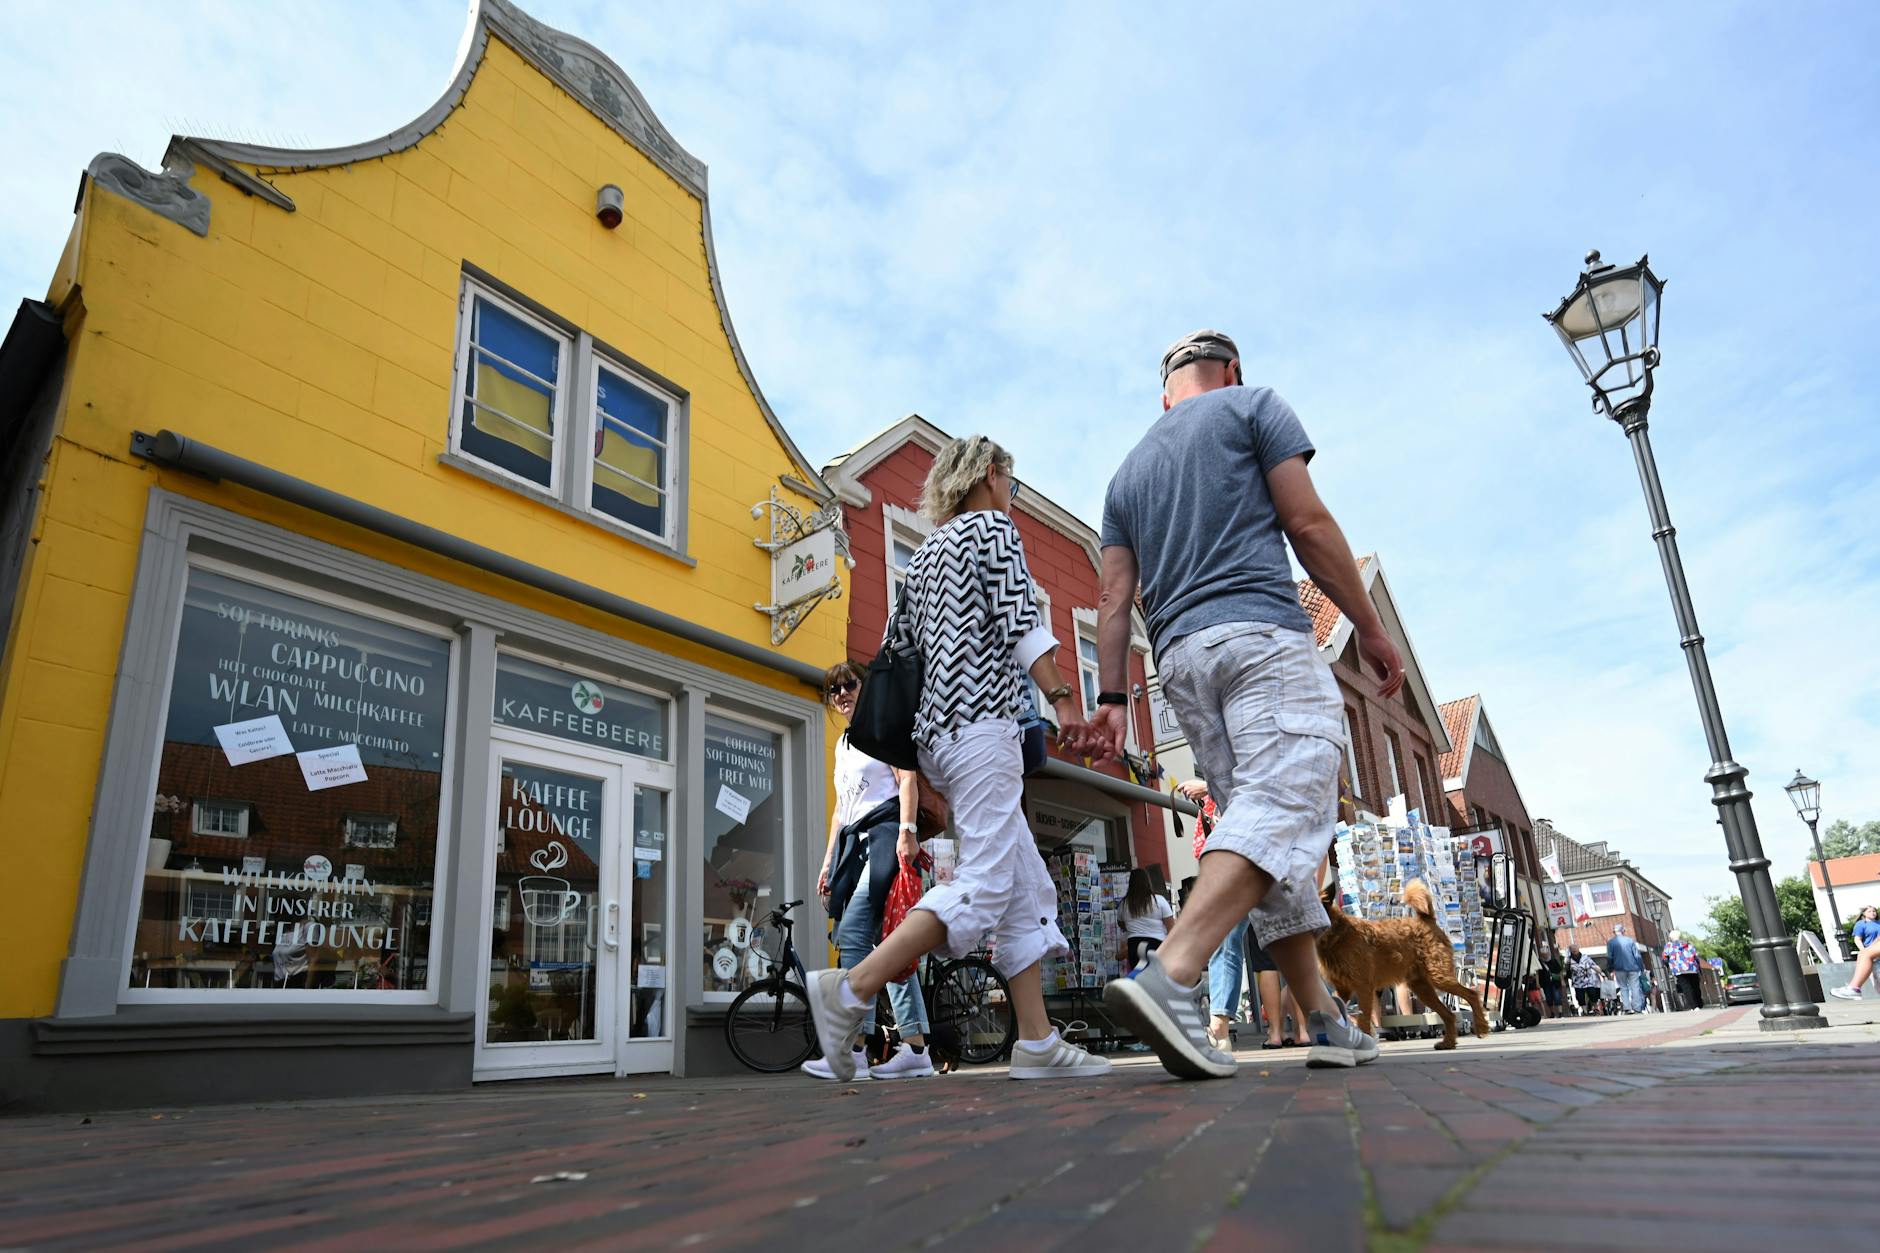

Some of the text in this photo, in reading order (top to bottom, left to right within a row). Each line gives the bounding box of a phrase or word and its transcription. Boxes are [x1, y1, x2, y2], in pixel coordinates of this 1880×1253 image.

[217, 602, 341, 649] SOFTDRINKS
[218, 658, 328, 692] HOT CHOCOLATE
[271, 642, 425, 697] CAPPUCCINO
[209, 672, 300, 716] WLAN
[313, 691, 425, 728] MILCHKAFFEE
[292, 720, 410, 754] LATTE MACCHIATO
[502, 697, 663, 752] KAFFEEBEERE
[317, 751, 340, 760] Special
[705, 747, 766, 773] SOFTDRINKS
[725, 736, 776, 759] COFFEE2GO
[310, 763, 358, 777] Latte Macchiato
[324, 774, 350, 783] Popcorn
[719, 767, 773, 791] FREE WIFI
[512, 777, 592, 812] KAFFEE
[506, 805, 593, 840] LOUNGE
[222, 865, 376, 897] WILLKOMMEN
[234, 894, 354, 920] IN UNSERER
[178, 915, 400, 950] KAFFEELOUNGE
